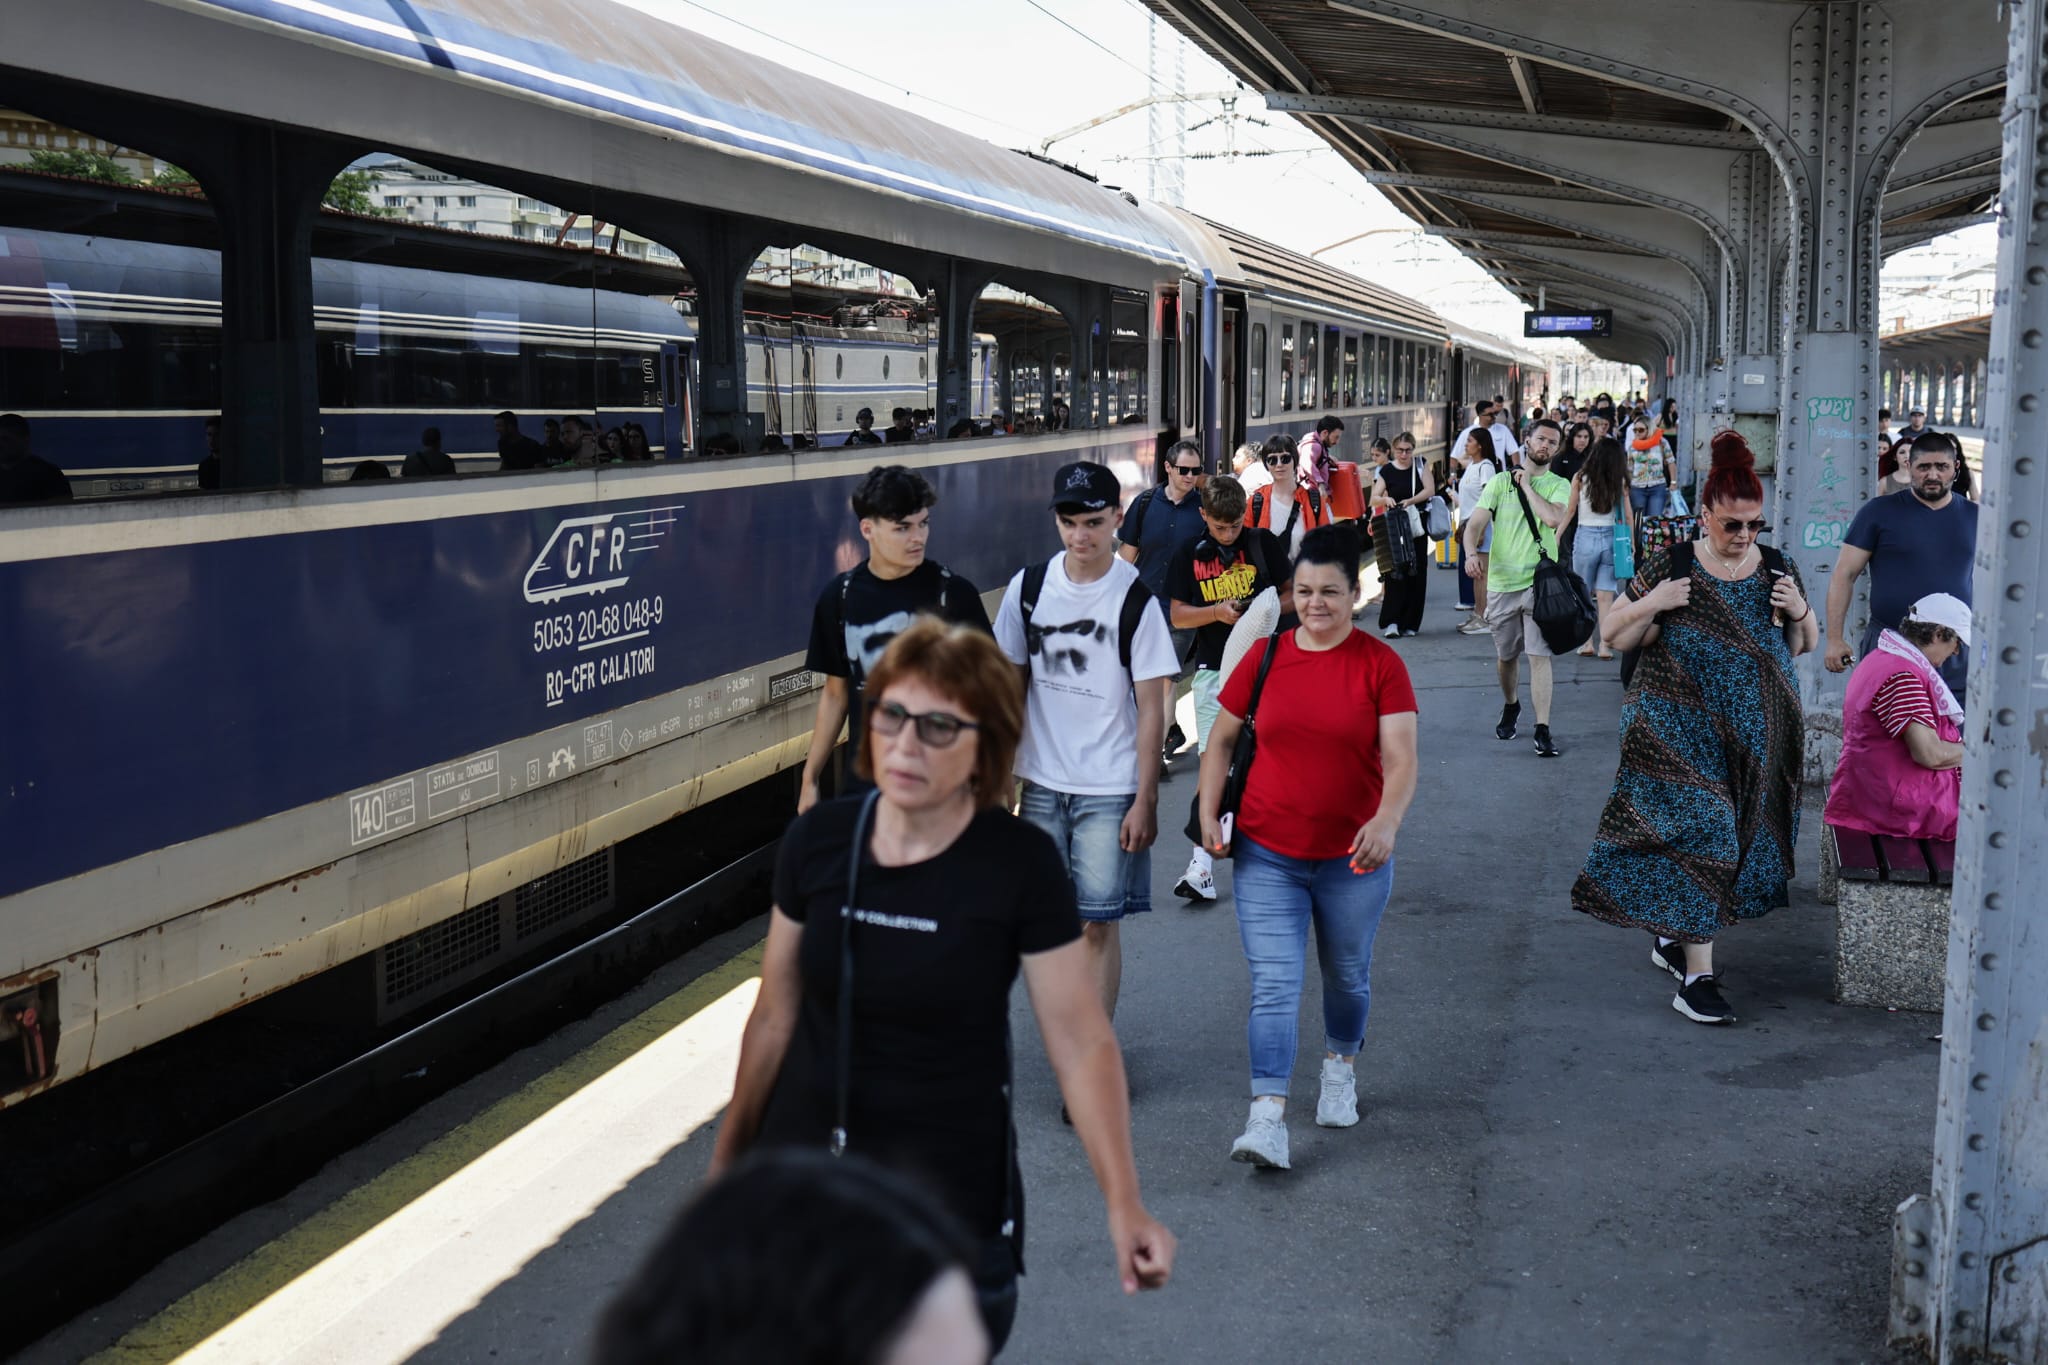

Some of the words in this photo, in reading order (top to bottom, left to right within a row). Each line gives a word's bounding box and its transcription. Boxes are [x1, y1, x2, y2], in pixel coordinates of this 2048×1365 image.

[566, 526, 625, 579] CFR
[534, 614, 573, 652] 5053
[578, 604, 620, 642] 20-68
[624, 596, 663, 631] 048-9
[546, 661, 595, 702] RO-CFR
[600, 646, 655, 685] CALATORI
[433, 772, 455, 790] STATIA
[354, 795, 384, 838] 140
